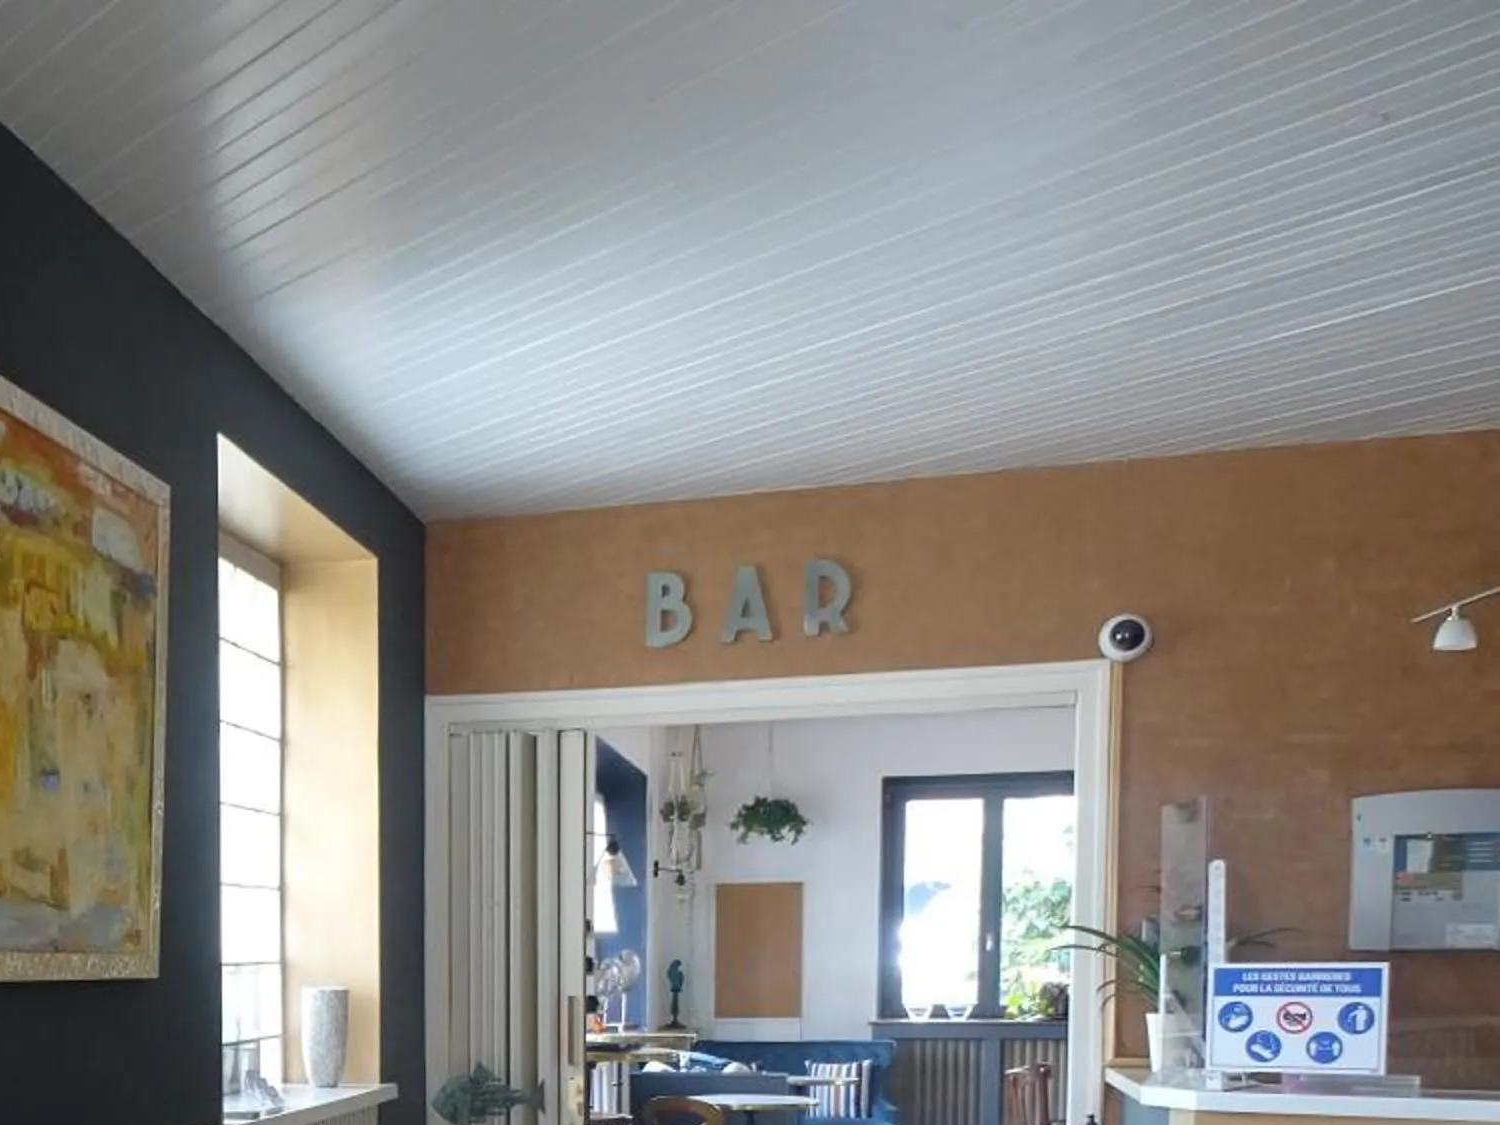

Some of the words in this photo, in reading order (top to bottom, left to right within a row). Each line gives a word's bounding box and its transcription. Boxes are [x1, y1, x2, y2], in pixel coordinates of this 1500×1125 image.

[646, 560, 851, 647] BAR
[1242, 972, 1258, 981] LES
[1233, 984, 1258, 993] POUR
[1260, 984, 1272, 993] LA
[1335, 984, 1361, 993] TOUS
